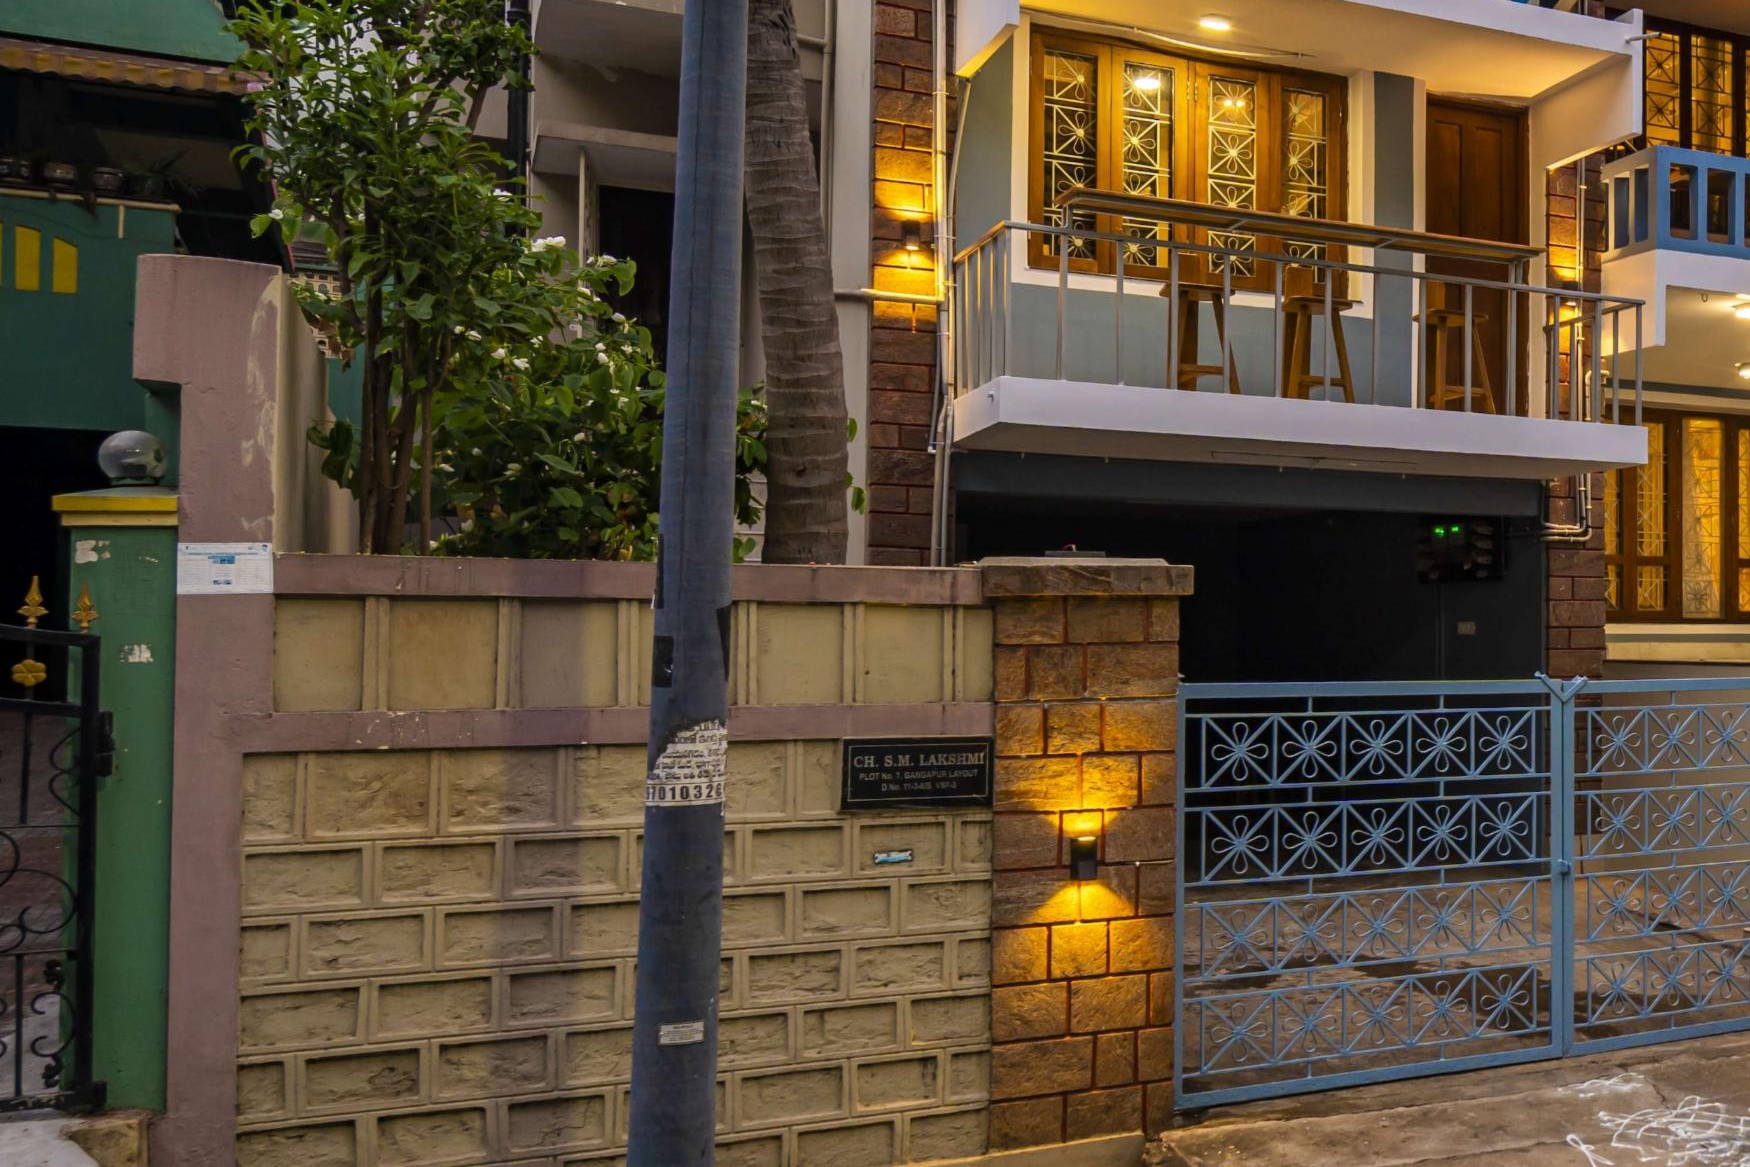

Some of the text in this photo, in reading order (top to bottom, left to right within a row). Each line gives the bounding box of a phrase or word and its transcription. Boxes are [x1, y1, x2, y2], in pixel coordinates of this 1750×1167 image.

[854, 752, 985, 768] CH. S.M. LAKSHMI
[859, 772, 880, 781] PLOT
[904, 770, 947, 779] GANGAPUR
[948, 769, 978, 778] LAYOUT
